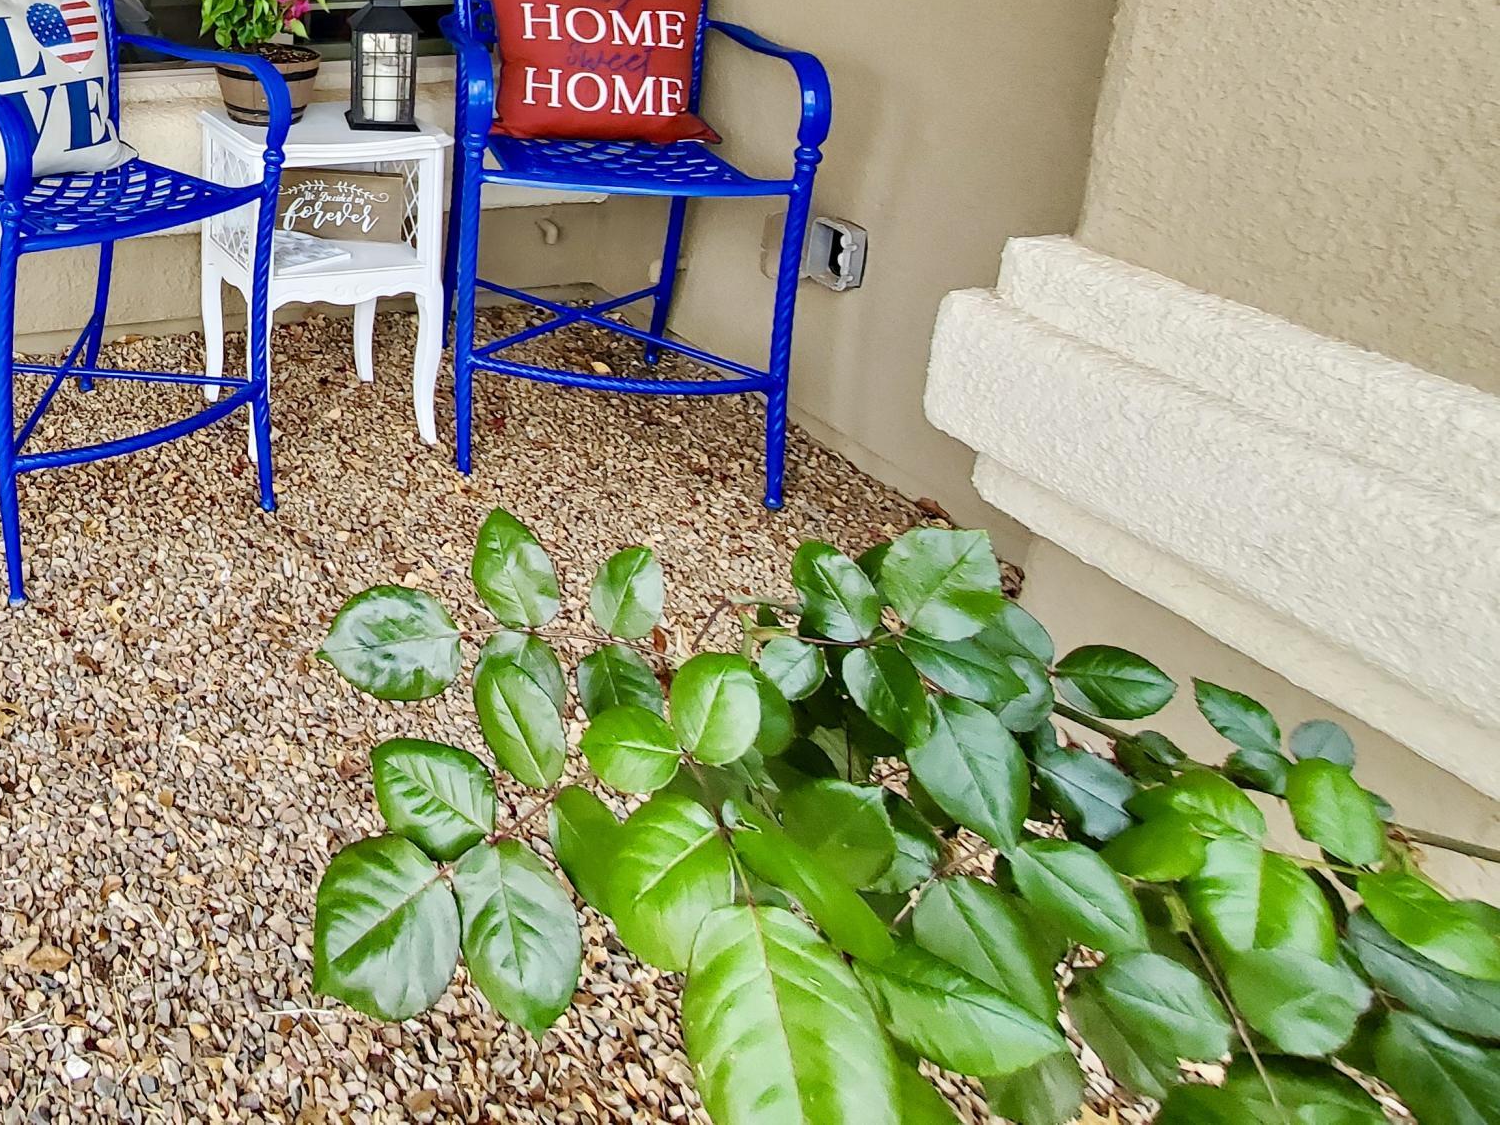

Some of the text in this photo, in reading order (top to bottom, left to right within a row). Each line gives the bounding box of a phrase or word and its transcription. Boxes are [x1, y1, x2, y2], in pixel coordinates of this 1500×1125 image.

[520, 3, 686, 49] HOME
[522, 66, 687, 116] HOME
[280, 197, 380, 233] forever
